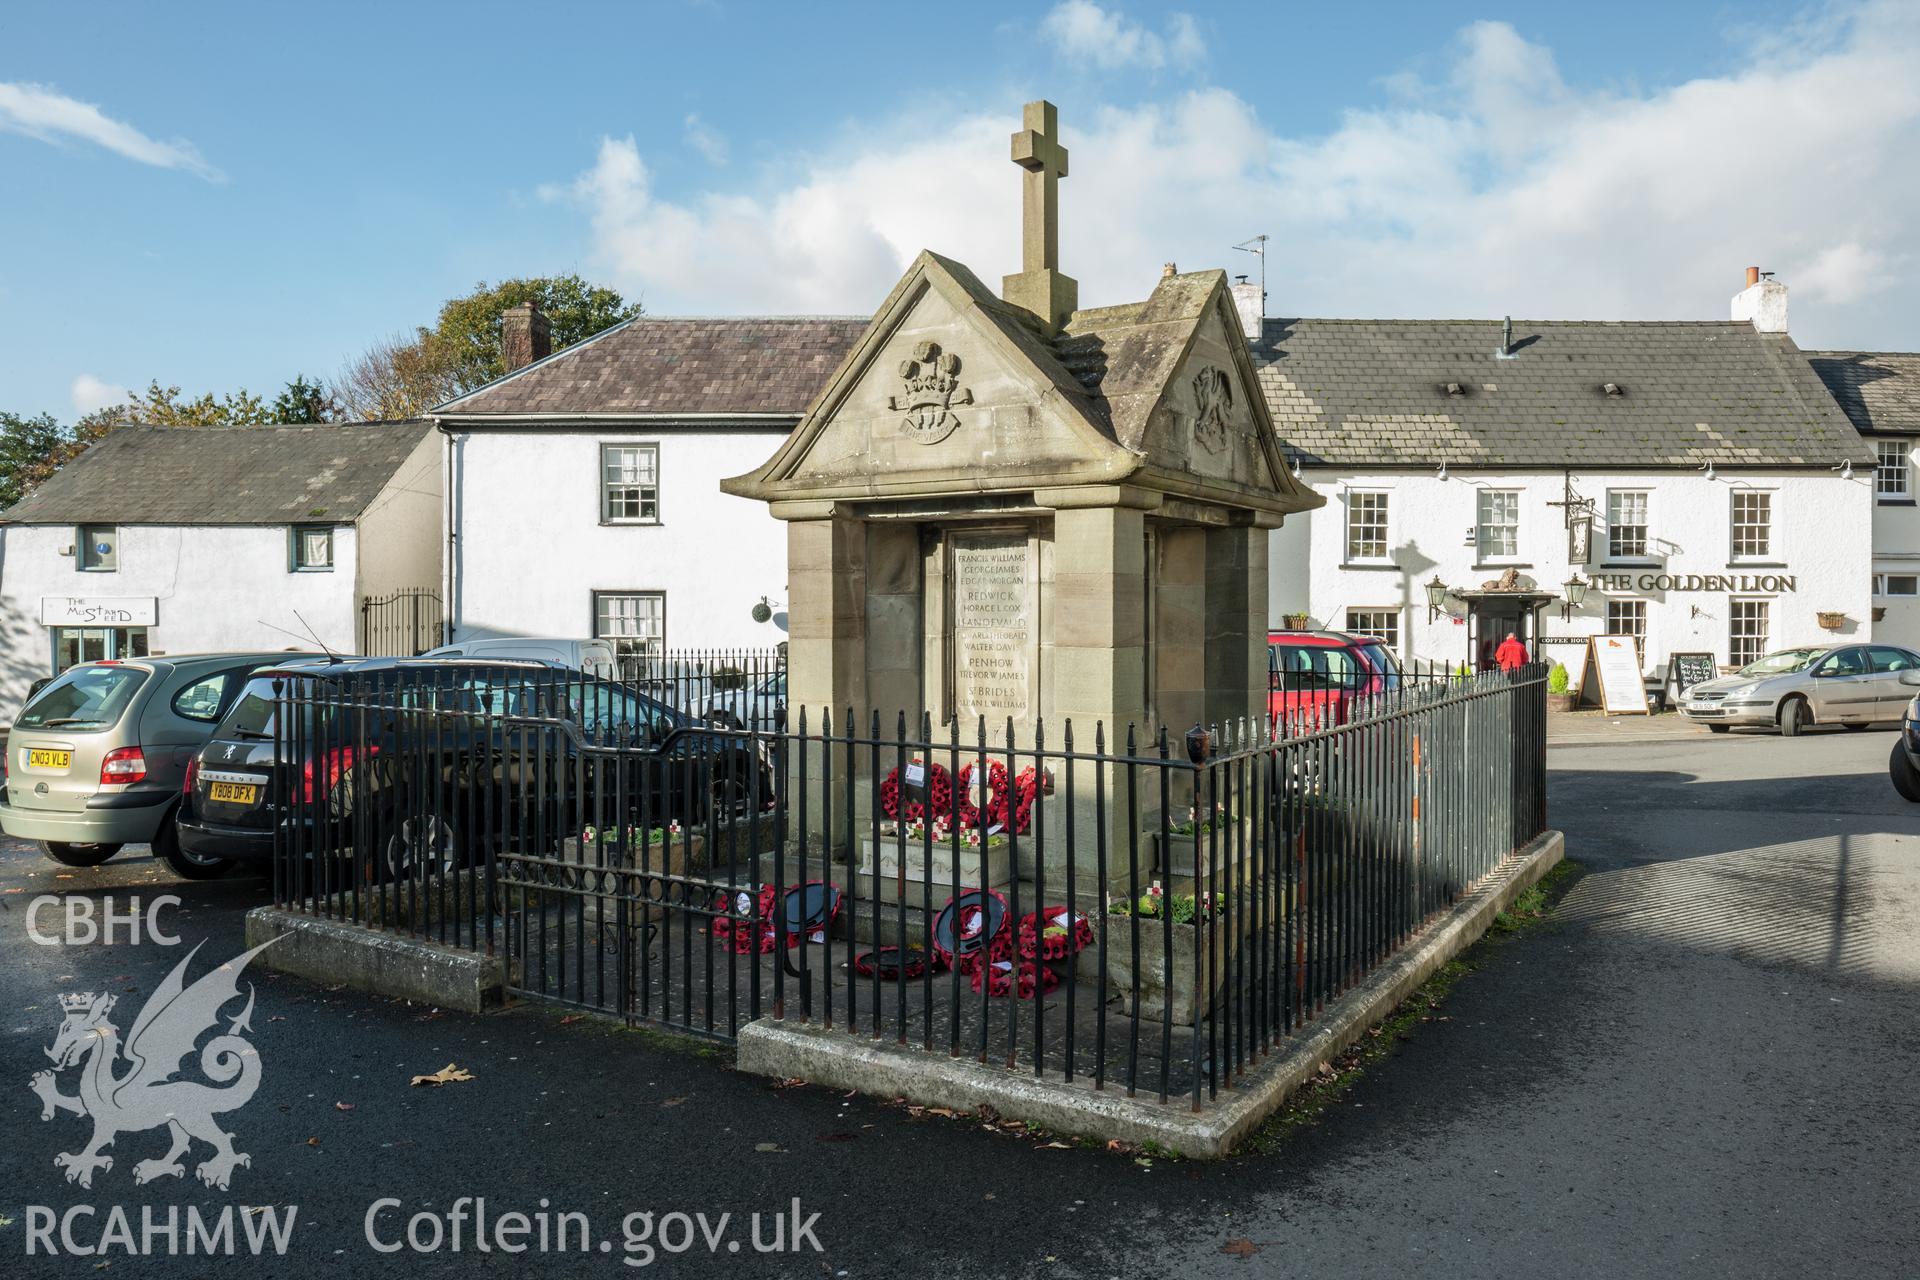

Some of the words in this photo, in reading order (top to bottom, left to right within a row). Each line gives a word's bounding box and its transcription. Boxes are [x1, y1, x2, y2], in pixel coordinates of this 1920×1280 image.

[991, 554, 1026, 562] WILLIAMS
[965, 565, 994, 574] GEORGE
[995, 565, 1020, 574] JAMES
[990, 576, 1024, 585] MORGAN
[1587, 574, 1633, 591] THE
[1637, 574, 1736, 592] GOLDEN
[1740, 574, 1798, 592] LION
[968, 591, 1014, 601] REDWICK
[66, 597, 86, 606] THE
[963, 604, 994, 612] HORACE
[1003, 604, 1021, 612] COX
[1541, 636, 1569, 644] COFFEE
[965, 643, 994, 651] WALTER
[970, 658, 1014, 668] PENHOW
[959, 671, 989, 679] TREVOR
[999, 671, 1025, 680] JAMES
[978, 686, 1017, 697] BRIDES
[990, 700, 1027, 709] WILLIAMS
[30, 751, 50, 765] CN03
[52, 752, 69, 766] VLB
[213, 783, 232, 799] YB08
[233, 785, 252, 801] DFX
